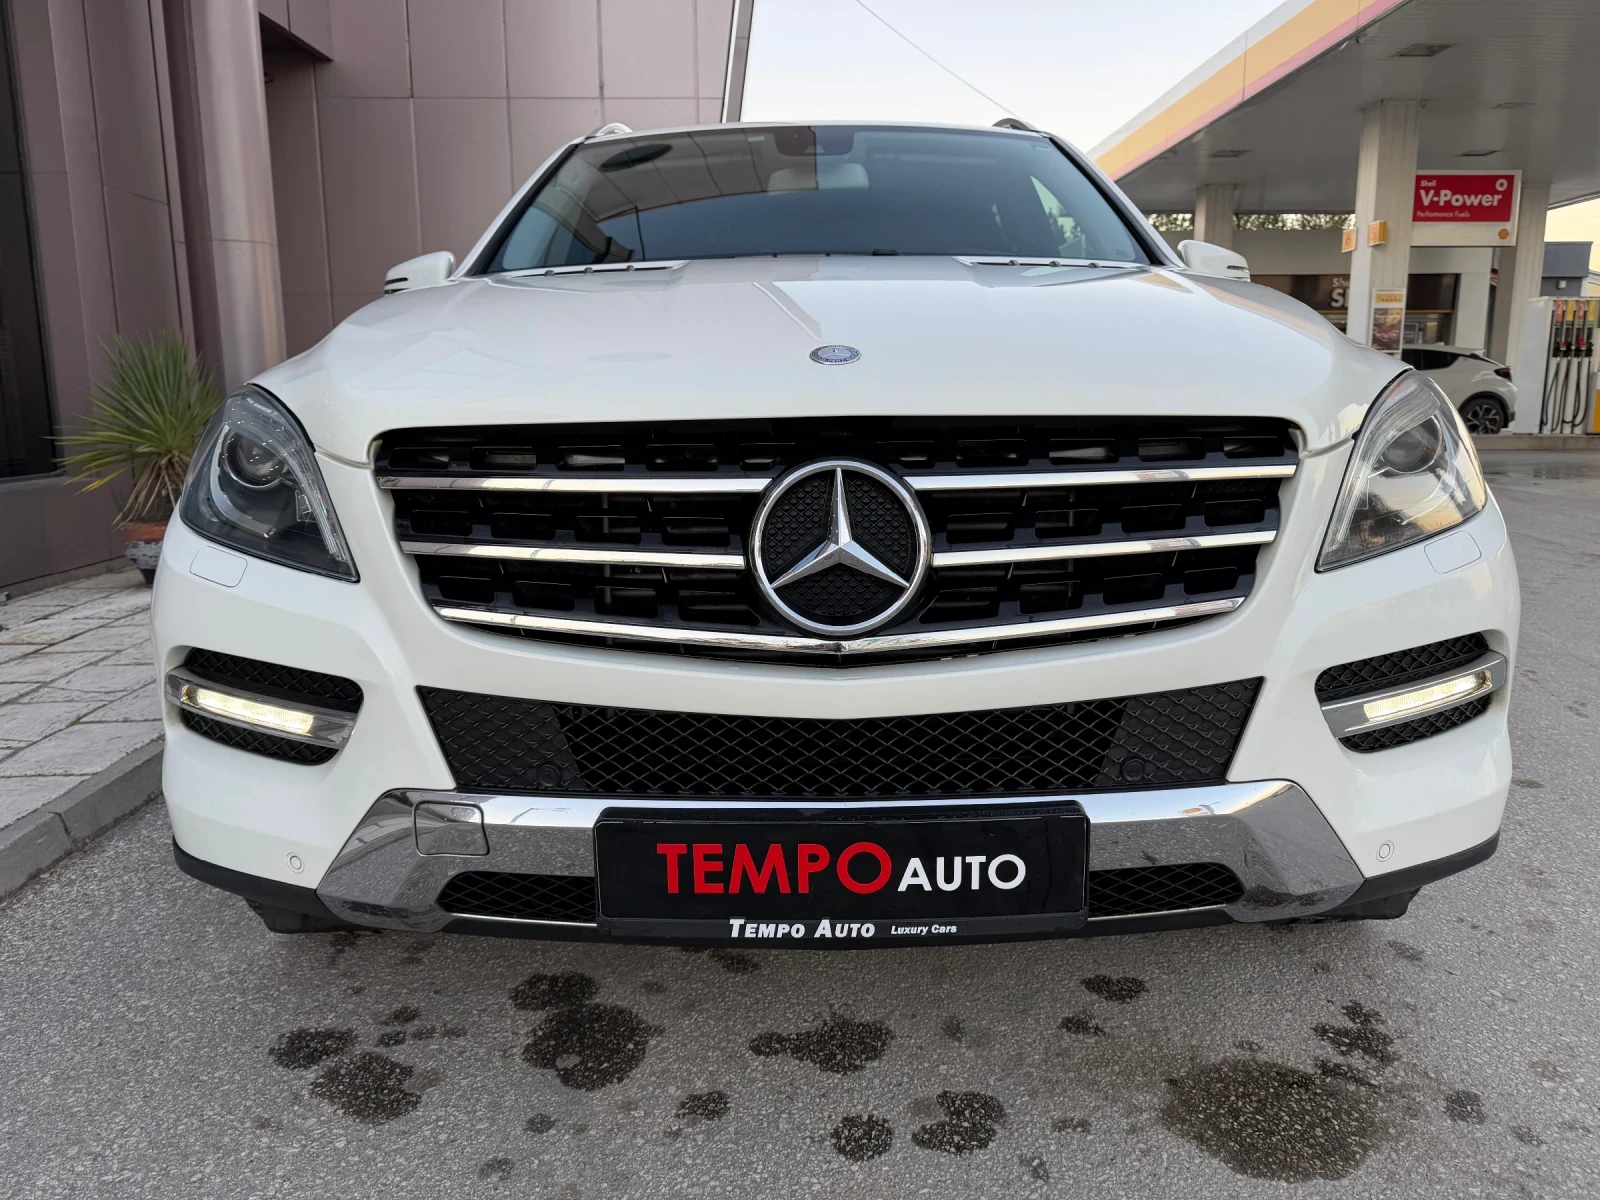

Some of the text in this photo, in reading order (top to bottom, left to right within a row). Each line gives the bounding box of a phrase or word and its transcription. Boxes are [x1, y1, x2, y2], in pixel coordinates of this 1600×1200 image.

[1419, 189, 1503, 207] V-Power
[1416, 210, 1471, 218] Performance Fuels
[656, 841, 1027, 895] TEMPO AUTO
[890, 925, 928, 935] Luxury
[930, 924, 958, 934] Cars
